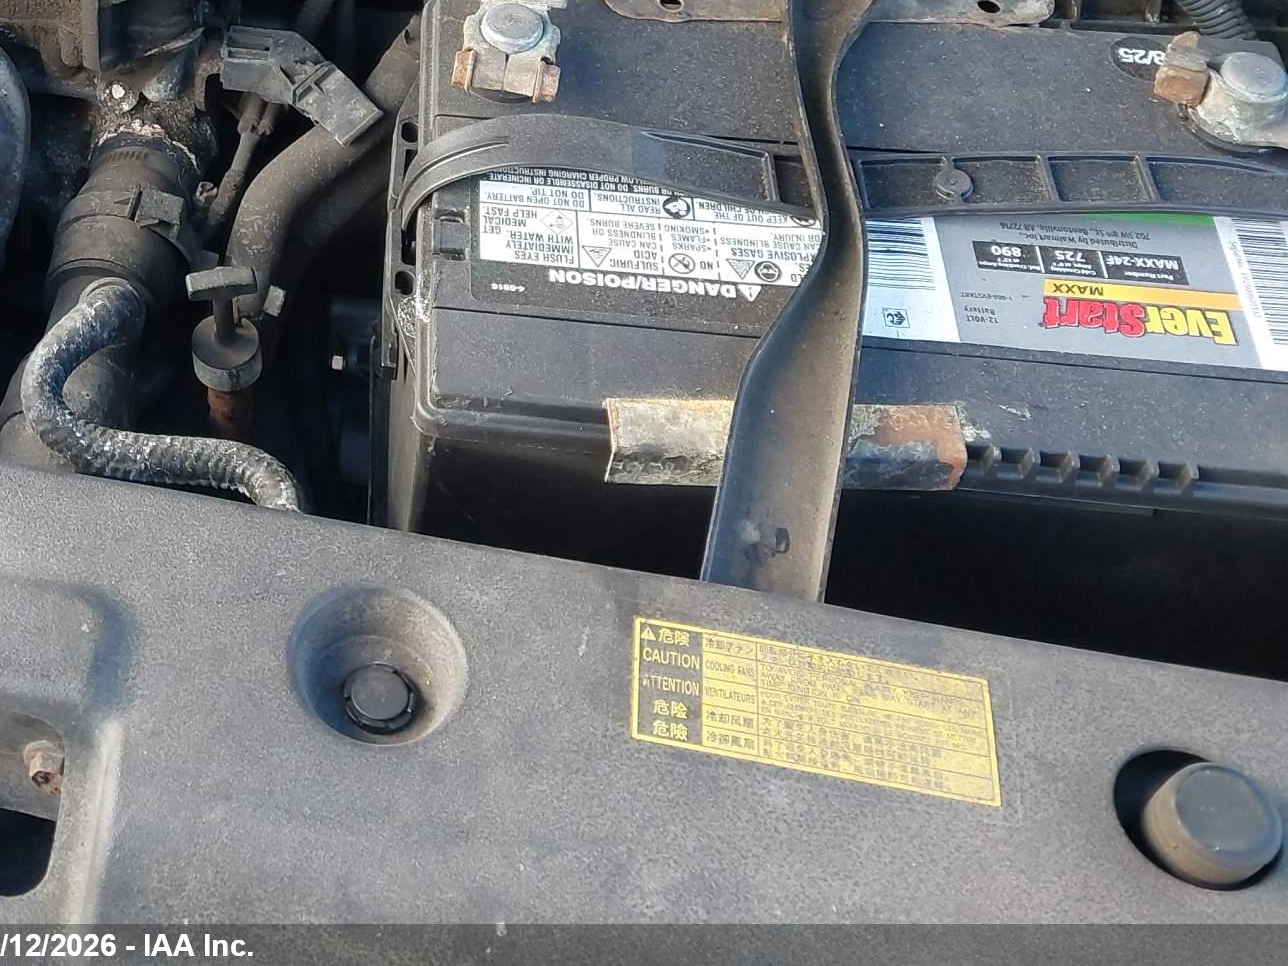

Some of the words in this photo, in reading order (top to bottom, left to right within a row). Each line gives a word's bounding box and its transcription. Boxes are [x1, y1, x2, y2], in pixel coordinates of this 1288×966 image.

[486, 172, 532, 184] INCINERATE.
[548, 170, 587, 180] CHARGING
[588, 174, 619, 182] PROPER
[546, 177, 598, 189] DISASSEMBLE
[600, 182, 615, 190] NOT
[530, 187, 545, 195] TIP.
[630, 184, 659, 194] BURNS.
[484, 192, 524, 203] BATTERY.
[527, 196, 550, 205] OPEN
[552, 198, 569, 207] NOT
[593, 193, 660, 205] INSTRUCTIONS.
[573, 200, 584, 208] DO
[620, 204, 635, 213] ALL
[696, 202, 741, 212] CHILDREN.
[482, 206, 509, 216] FAST.
[513, 209, 537, 218] HELP
[638, 206, 660, 214] READ
[482, 215, 526, 227] MEDICAL
[713, 212, 728, 220] THE
[767, 215, 787, 224] KEEP
[586, 218, 619, 228] BURNS.
[622, 221, 654, 230] SEVERE
[1024, 224, 1034, 232] AR
[483, 226, 501, 234] GET
[607, 229, 656, 240] BLINDNESS
[1037, 224, 1088, 235] Bentonville,
[506, 230, 544, 241] WATER.
[548, 234, 573, 244] WITH
[770, 233, 804, 241] INJURY.
[808, 234, 820, 242] OR
[1039, 234, 1076, 243] Walmart
[1078, 236, 1088, 244] by
[1134, 232, 1150, 240] 702
[506, 240, 574, 254] IMMEDIATELY
[608, 239, 636, 248] CAUSE
[640, 241, 656, 249] CAN
[720, 237, 769, 248] BLINDNESS
[772, 241, 801, 249] CAUSE
[1090, 238, 1137, 248] Distributed
[515, 250, 539, 261] EYES
[633, 250, 657, 259] ACID
[731, 248, 763, 258] GASES
[991, 245, 1021, 257] 890
[543, 254, 574, 264] FLUSH
[1055, 251, 1086, 262] 725
[609, 259, 659, 271] SULFURIC
[700, 261, 713, 270] NO
[1105, 255, 1179, 270] MAXX-24F
[549, 269, 737, 298] DANGER/POISON
[1052, 282, 1104, 296] MAXX
[965, 306, 995, 315] Battery
[966, 315, 999, 324] 12-VOLT
[1042, 297, 1238, 346] EverStart
[642, 647, 700, 670] CAUTION
[705, 660, 735, 674] COOLING
[738, 665, 755, 678] FANS
[642, 674, 700, 696] ATTENTION
[705, 686, 756, 704] VENTILATEURS
